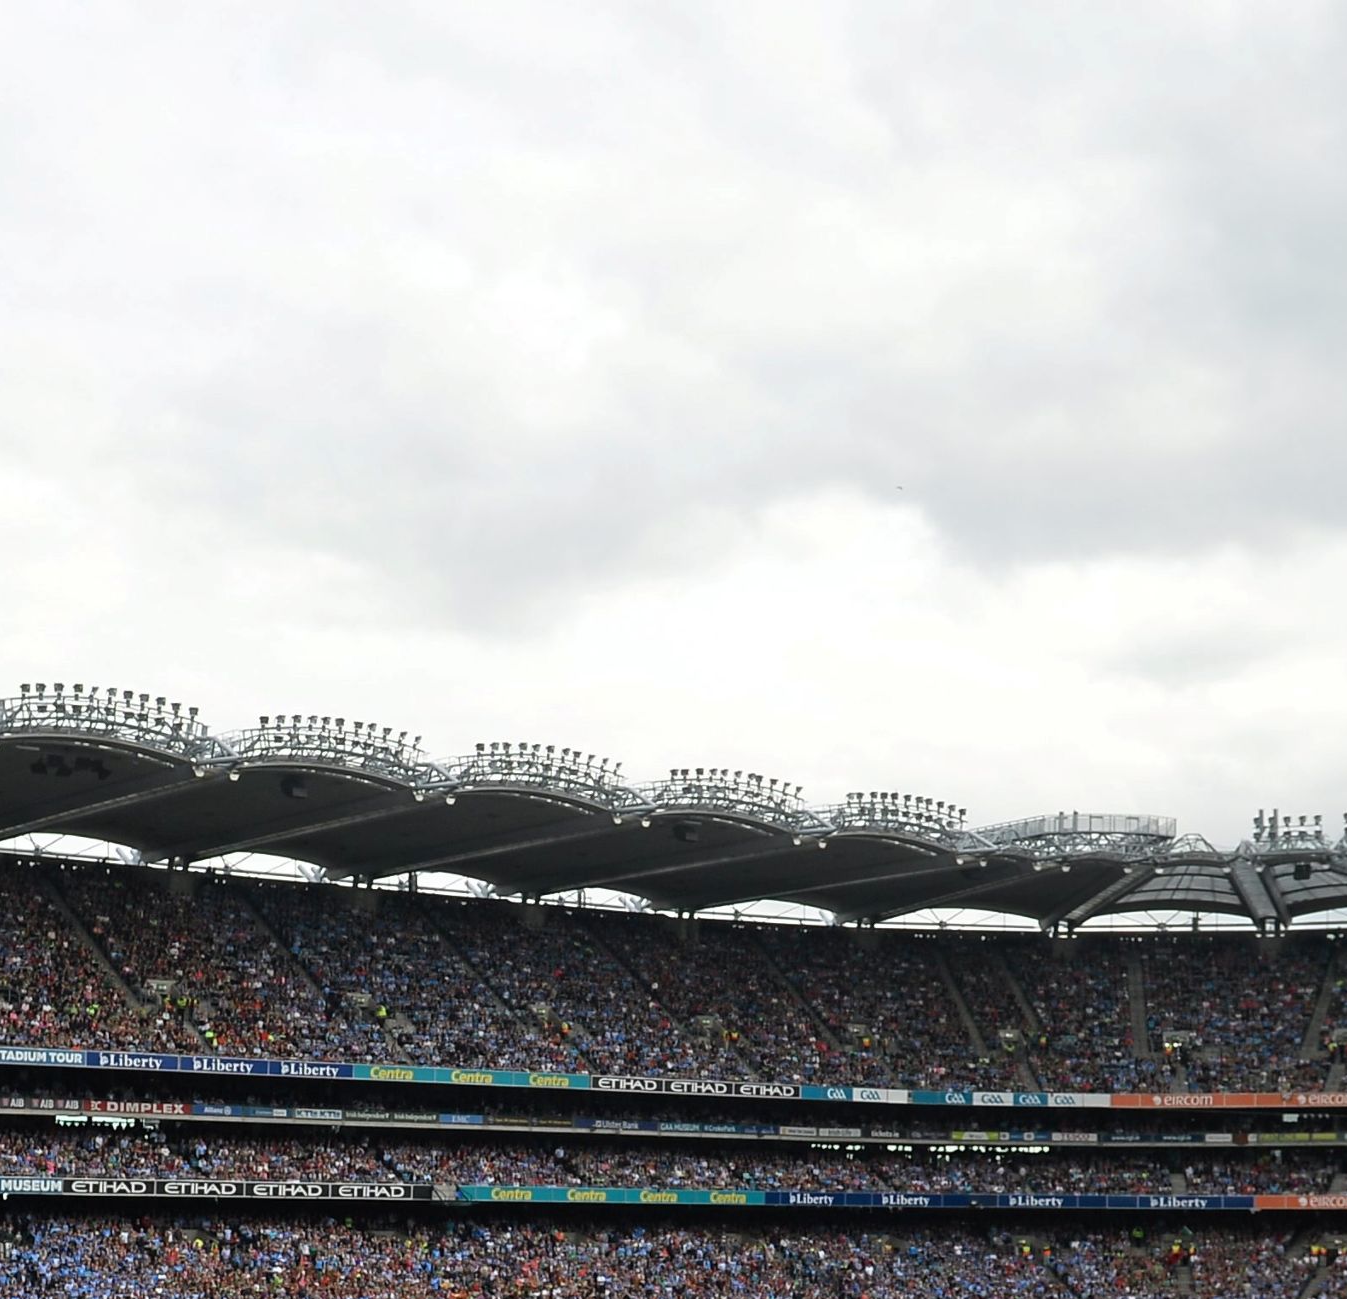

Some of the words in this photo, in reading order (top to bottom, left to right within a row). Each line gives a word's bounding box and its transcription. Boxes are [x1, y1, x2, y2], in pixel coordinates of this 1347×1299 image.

[49, 1052, 83, 1064] TOUR
[109, 1054, 163, 1071] Liberty
[203, 1059, 254, 1075] Liberty
[291, 1062, 339, 1078] Liberty
[370, 1067, 414, 1082] Centra
[451, 1070, 493, 1085] Centra
[529, 1073, 569, 1088] Centra
[598, 1077, 657, 1092] ETIHAD
[670, 1080, 727, 1095] ETIHAD
[740, 1084, 794, 1098] ETIHAD
[1164, 1094, 1213, 1106] eircom
[107, 1101, 185, 1115] DIMPLEX
[2, 1181, 62, 1193] MUSEUM
[71, 1181, 147, 1194] ETIHAD
[164, 1183, 237, 1196] ETIHAD
[253, 1185, 323, 1198] ETIHAD
[338, 1186, 405, 1199] ETIHAD
[491, 1188, 532, 1201] Centra
[568, 1189, 606, 1202] Centra
[640, 1190, 678, 1203] Centra
[710, 1191, 747, 1204] Centra
[796, 1194, 834, 1207] Liberty
